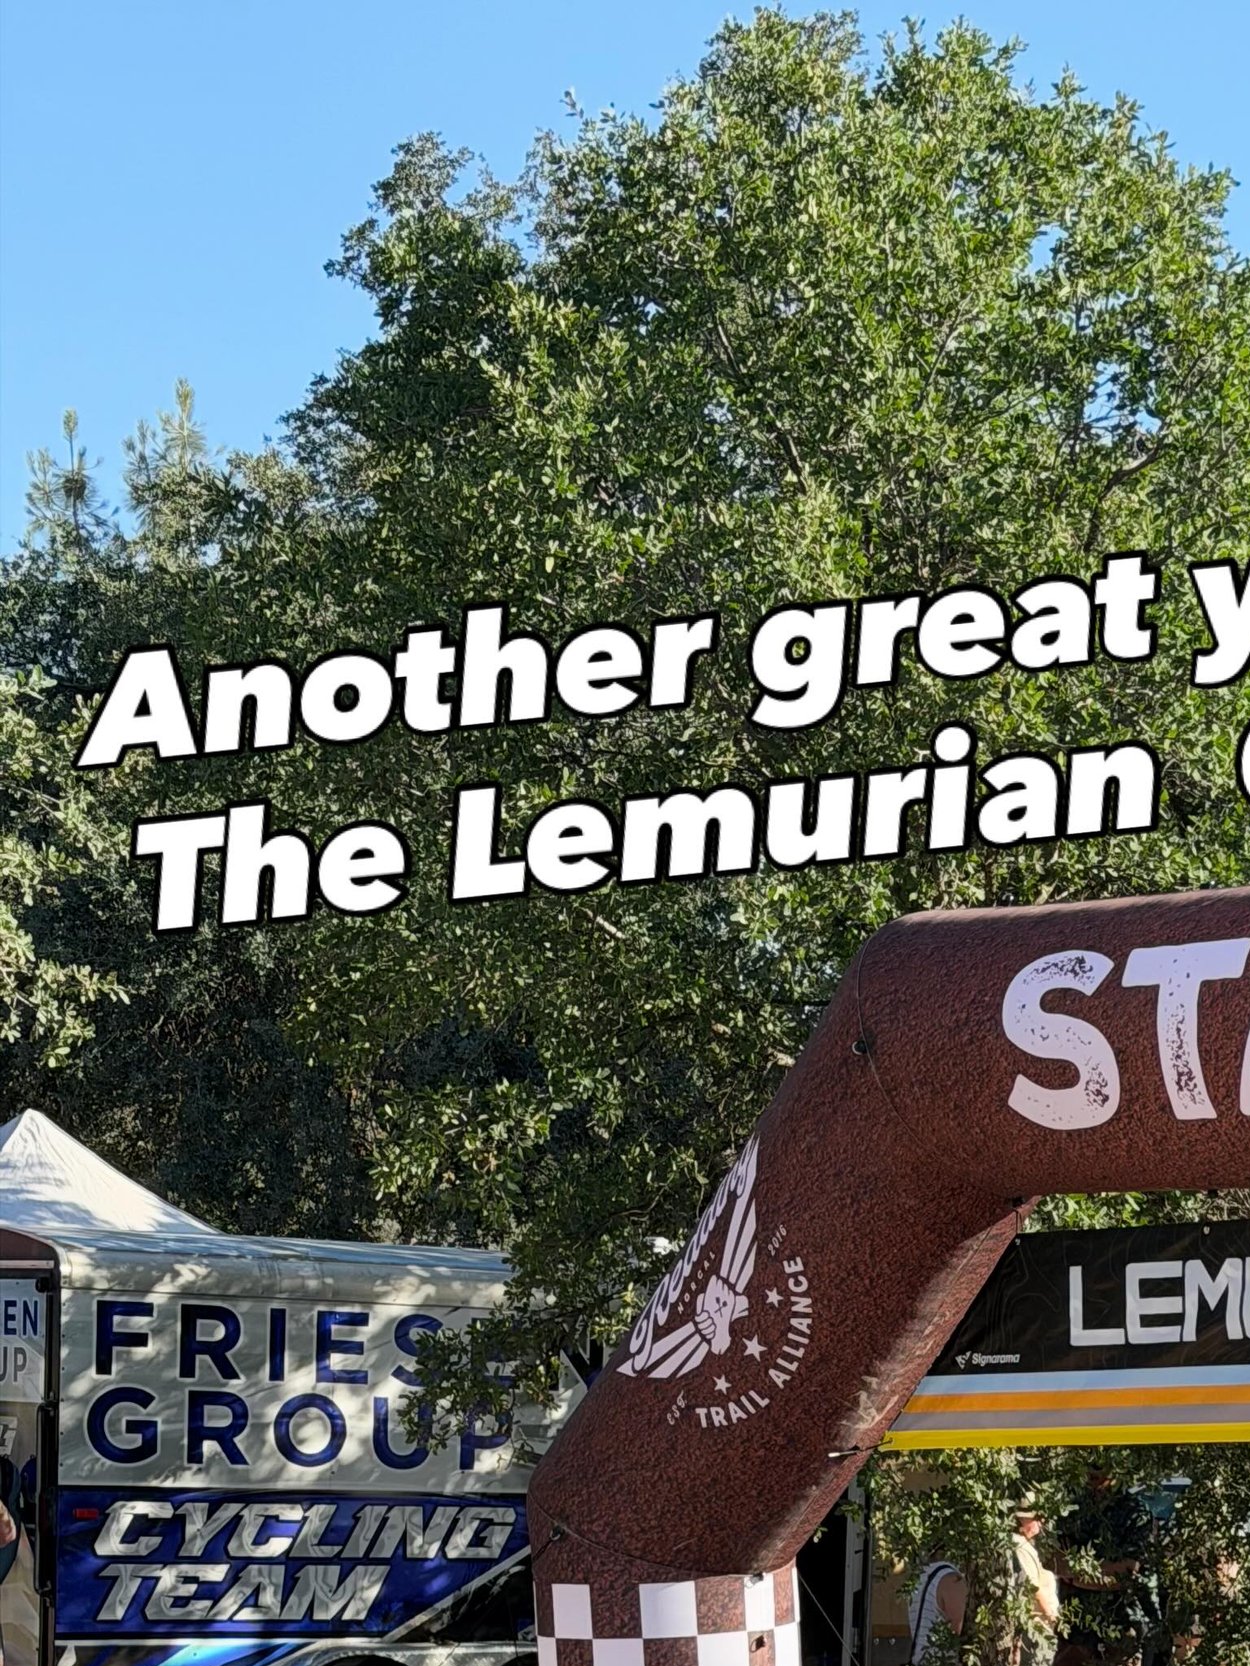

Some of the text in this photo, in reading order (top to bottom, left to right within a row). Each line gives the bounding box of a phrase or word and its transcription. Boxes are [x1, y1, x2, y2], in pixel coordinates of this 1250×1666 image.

[695, 1256, 813, 1429] TRAIL ALLIANCE
[87, 1386, 514, 1471] GROUP
[93, 1501, 517, 1560] CYCLING
[96, 1563, 391, 1622] TEAM
